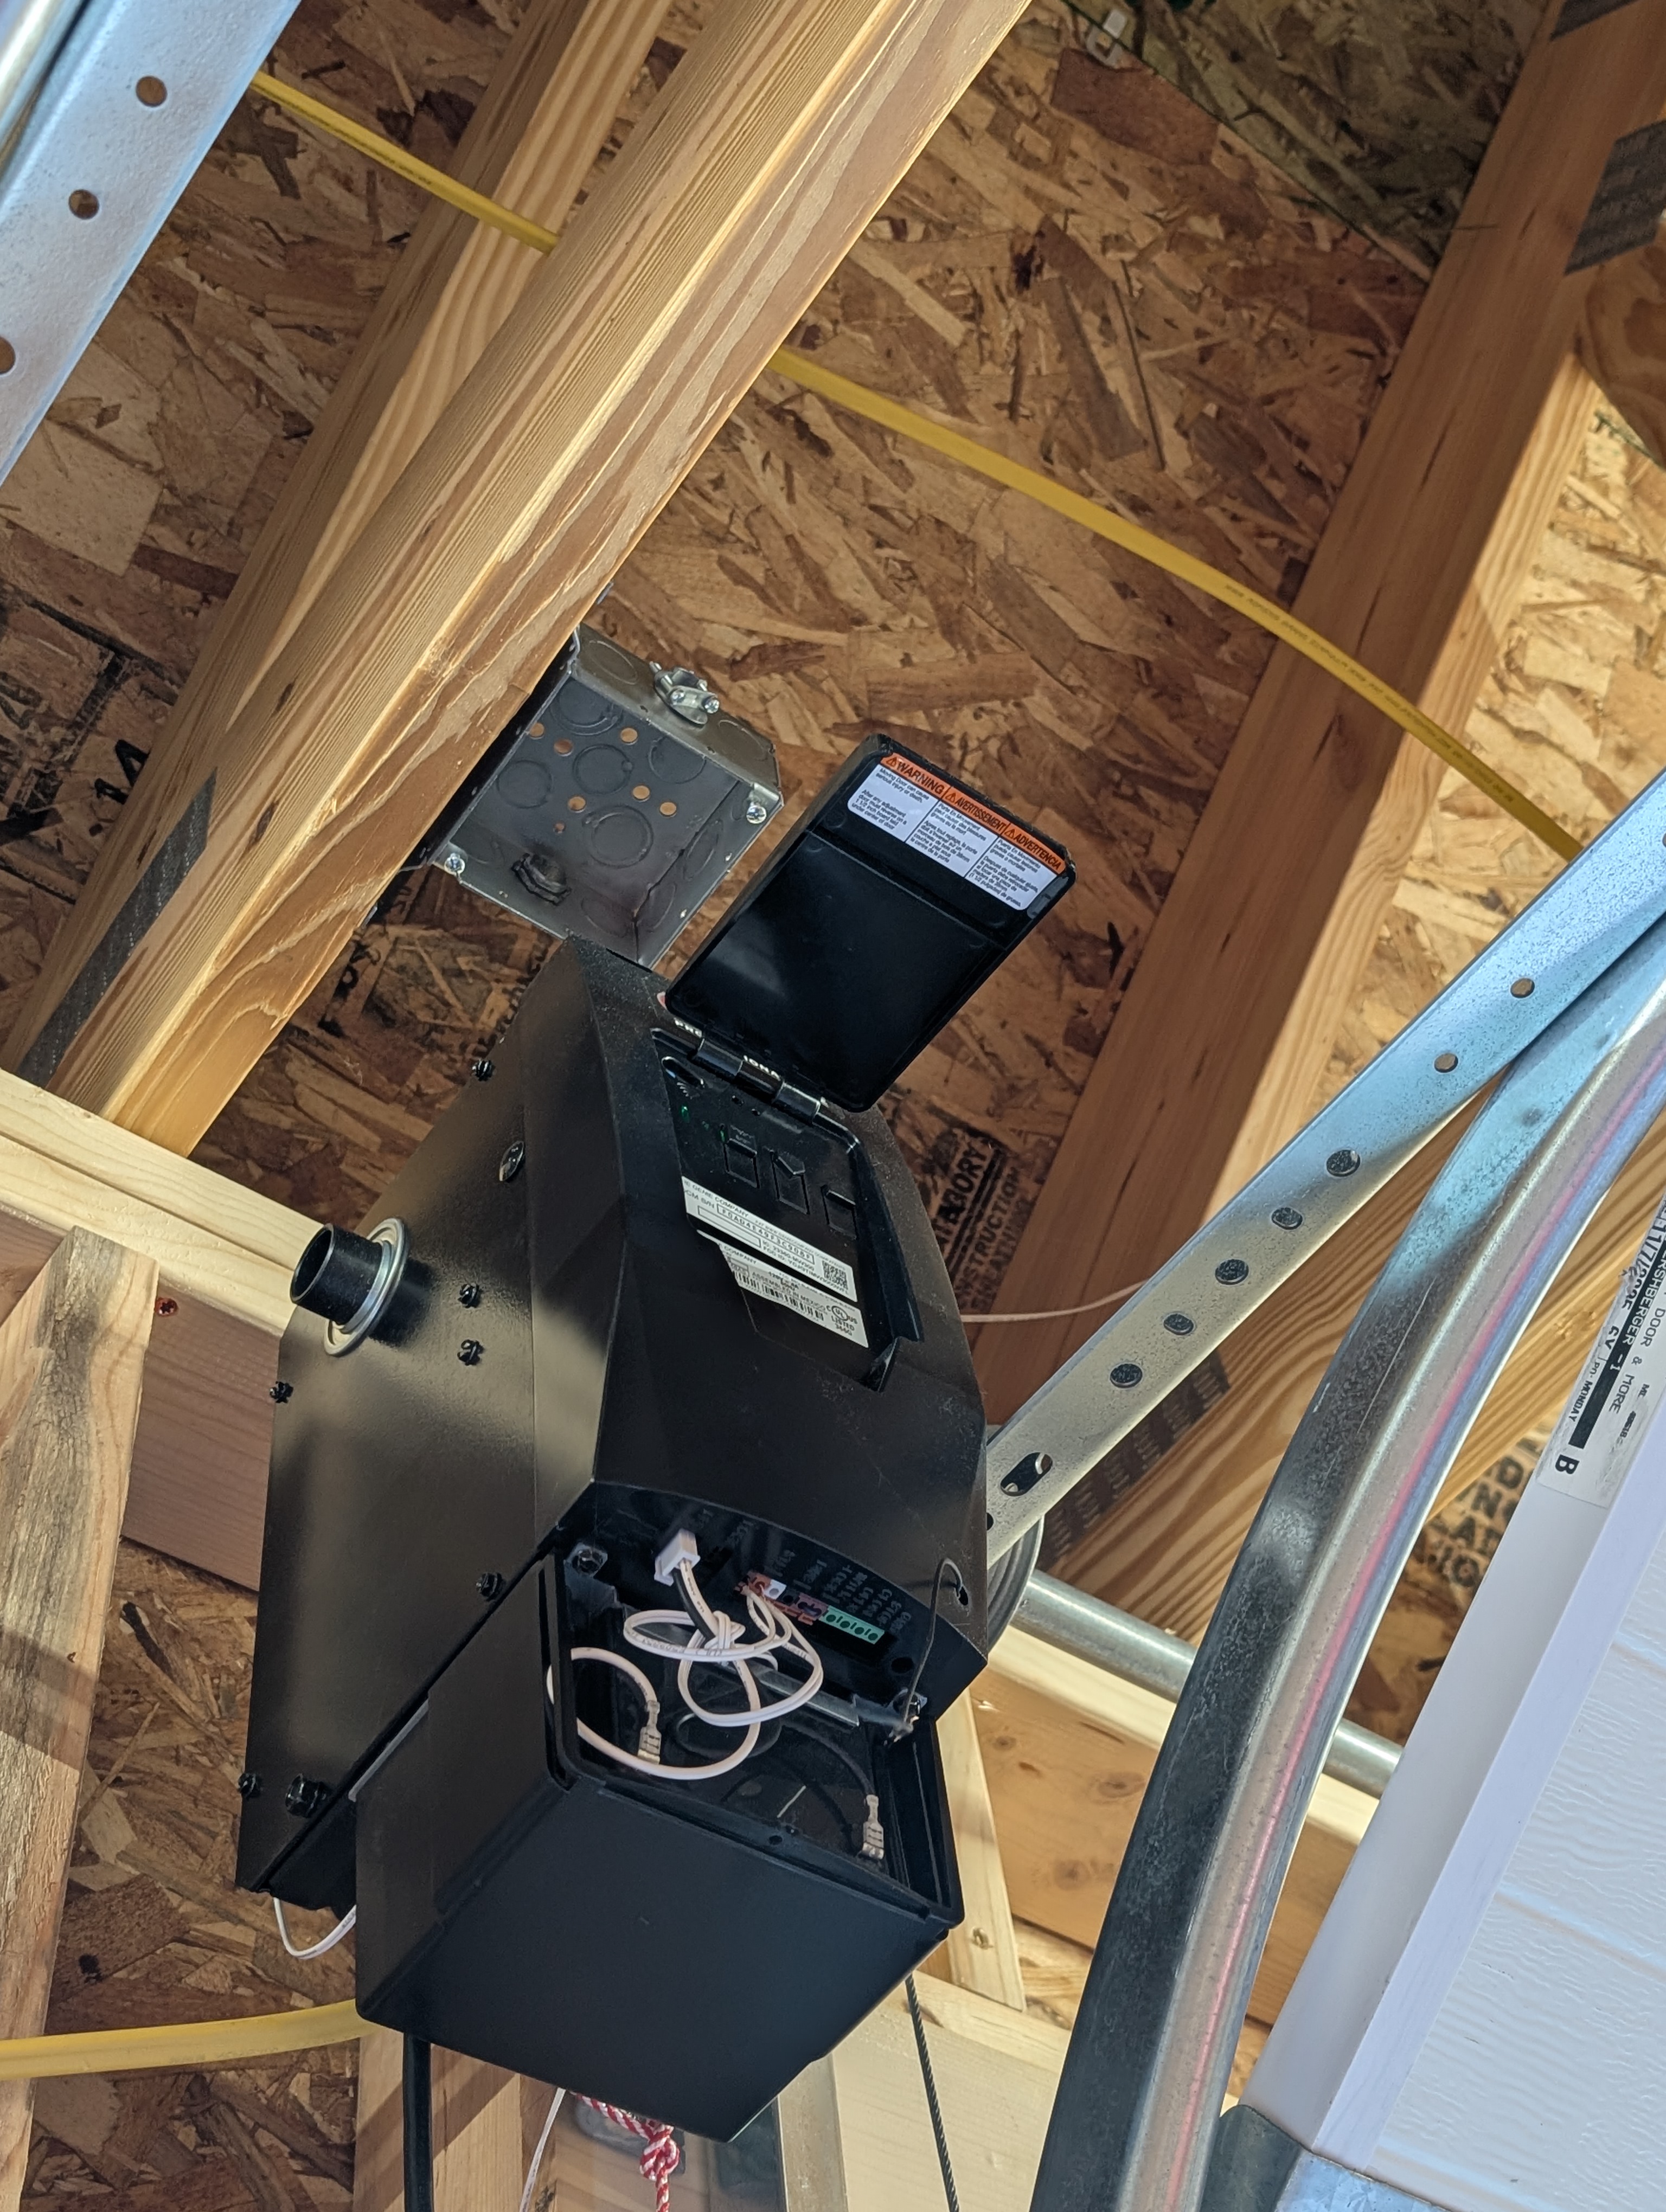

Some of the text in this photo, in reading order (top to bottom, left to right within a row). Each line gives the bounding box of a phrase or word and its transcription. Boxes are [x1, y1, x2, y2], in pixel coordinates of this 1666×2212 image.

[895, 761, 945, 794] WARNING
[954, 796, 1007, 831] AVERTISSEMENT
[1013, 833, 1061, 870] ADVERTENCIA
[684, 1189, 699, 1200] CM
[715, 1197, 748, 1217] COMPANY
[752, 1272, 791, 1294] ASSEMBLED
[800, 1295, 826, 1310] MEXICO
[1622, 1249, 1666, 1345] RSHBERGER
[831, 1316, 855, 1331] LISTED
[1609, 1308, 1665, 1414] DOOR & MORE
[1568, 1380, 1592, 1422] MONDAY
[1555, 1454, 1580, 1474] B
